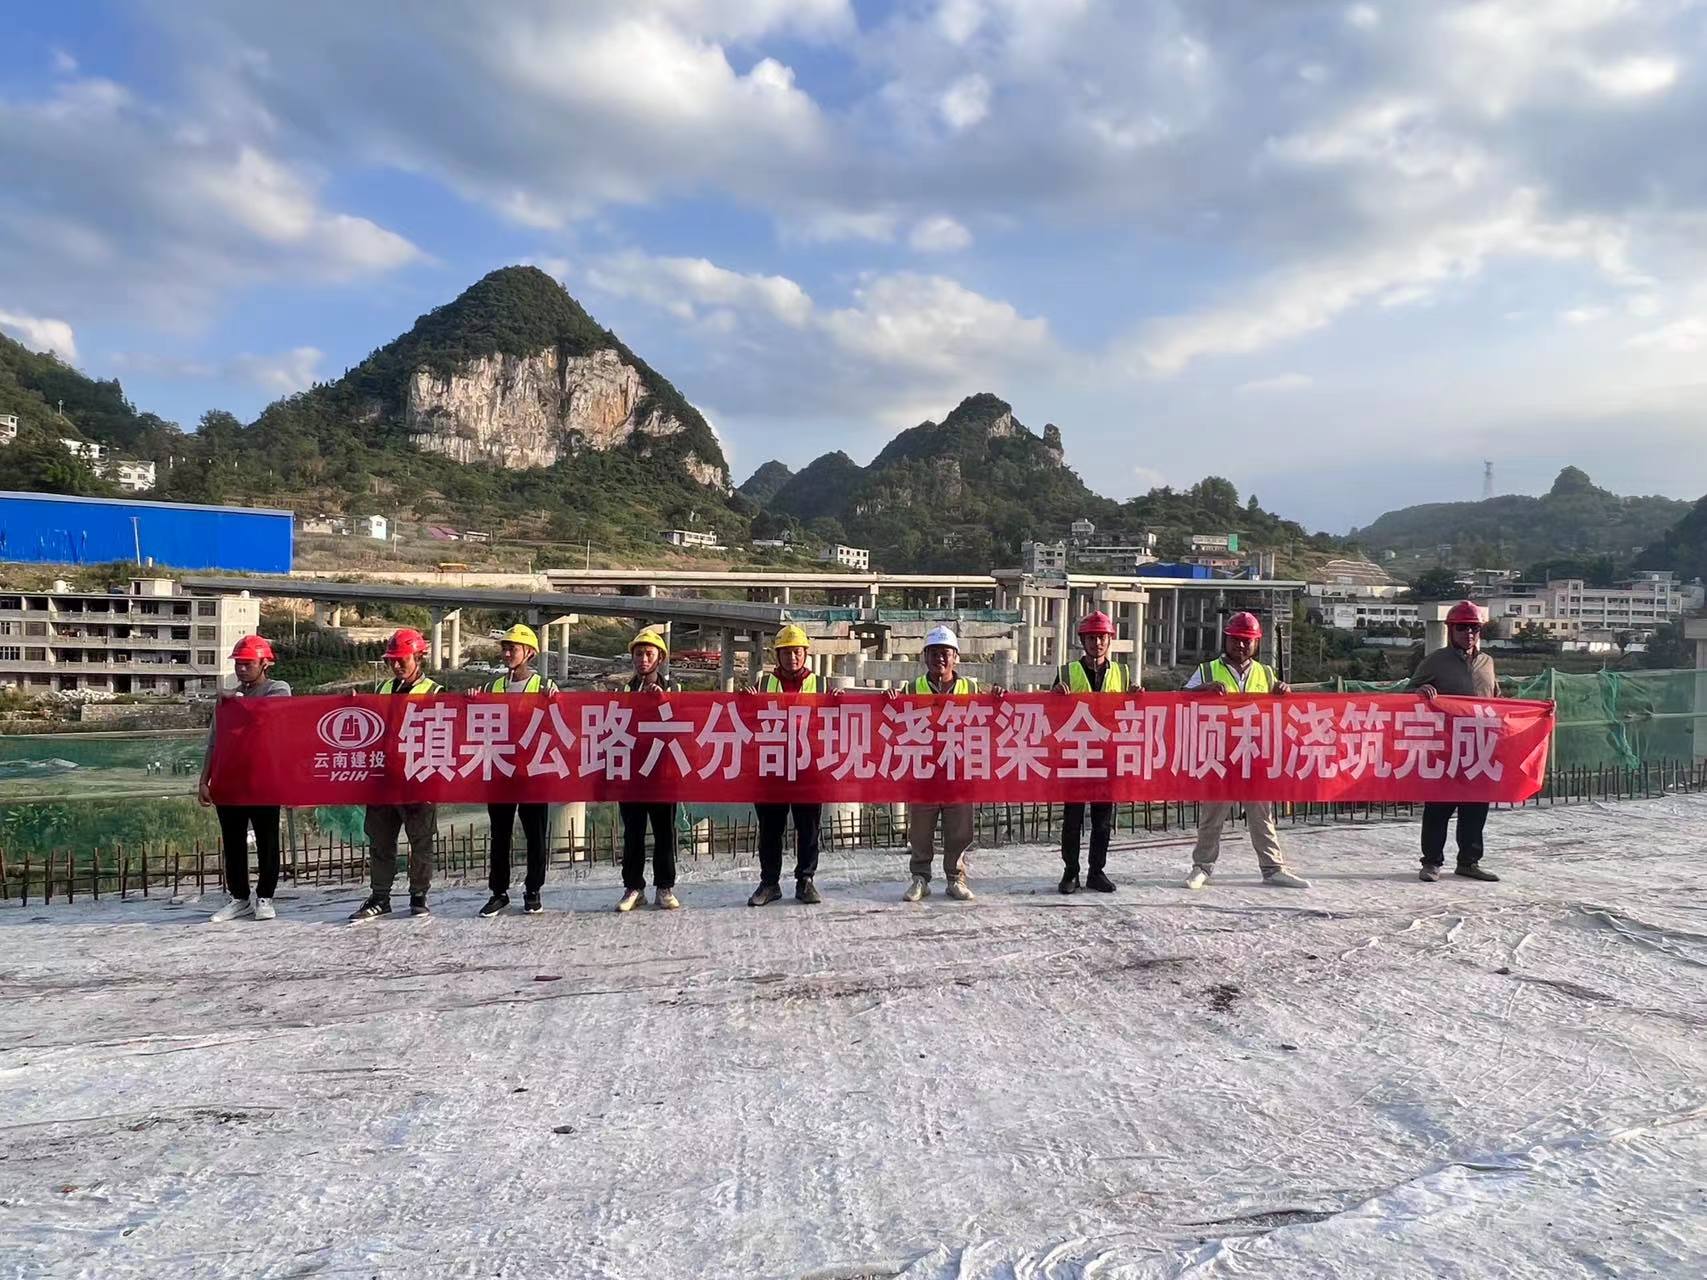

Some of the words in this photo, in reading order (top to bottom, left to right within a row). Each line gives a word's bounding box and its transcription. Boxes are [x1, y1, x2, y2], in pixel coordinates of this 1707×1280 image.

[398, 700, 1504, 783] 镇果公路六分部现浇箱梁全部顺利浇筑完成
[313, 750, 385, 769] 云南建投
[330, 770, 369, 782] YCIH
